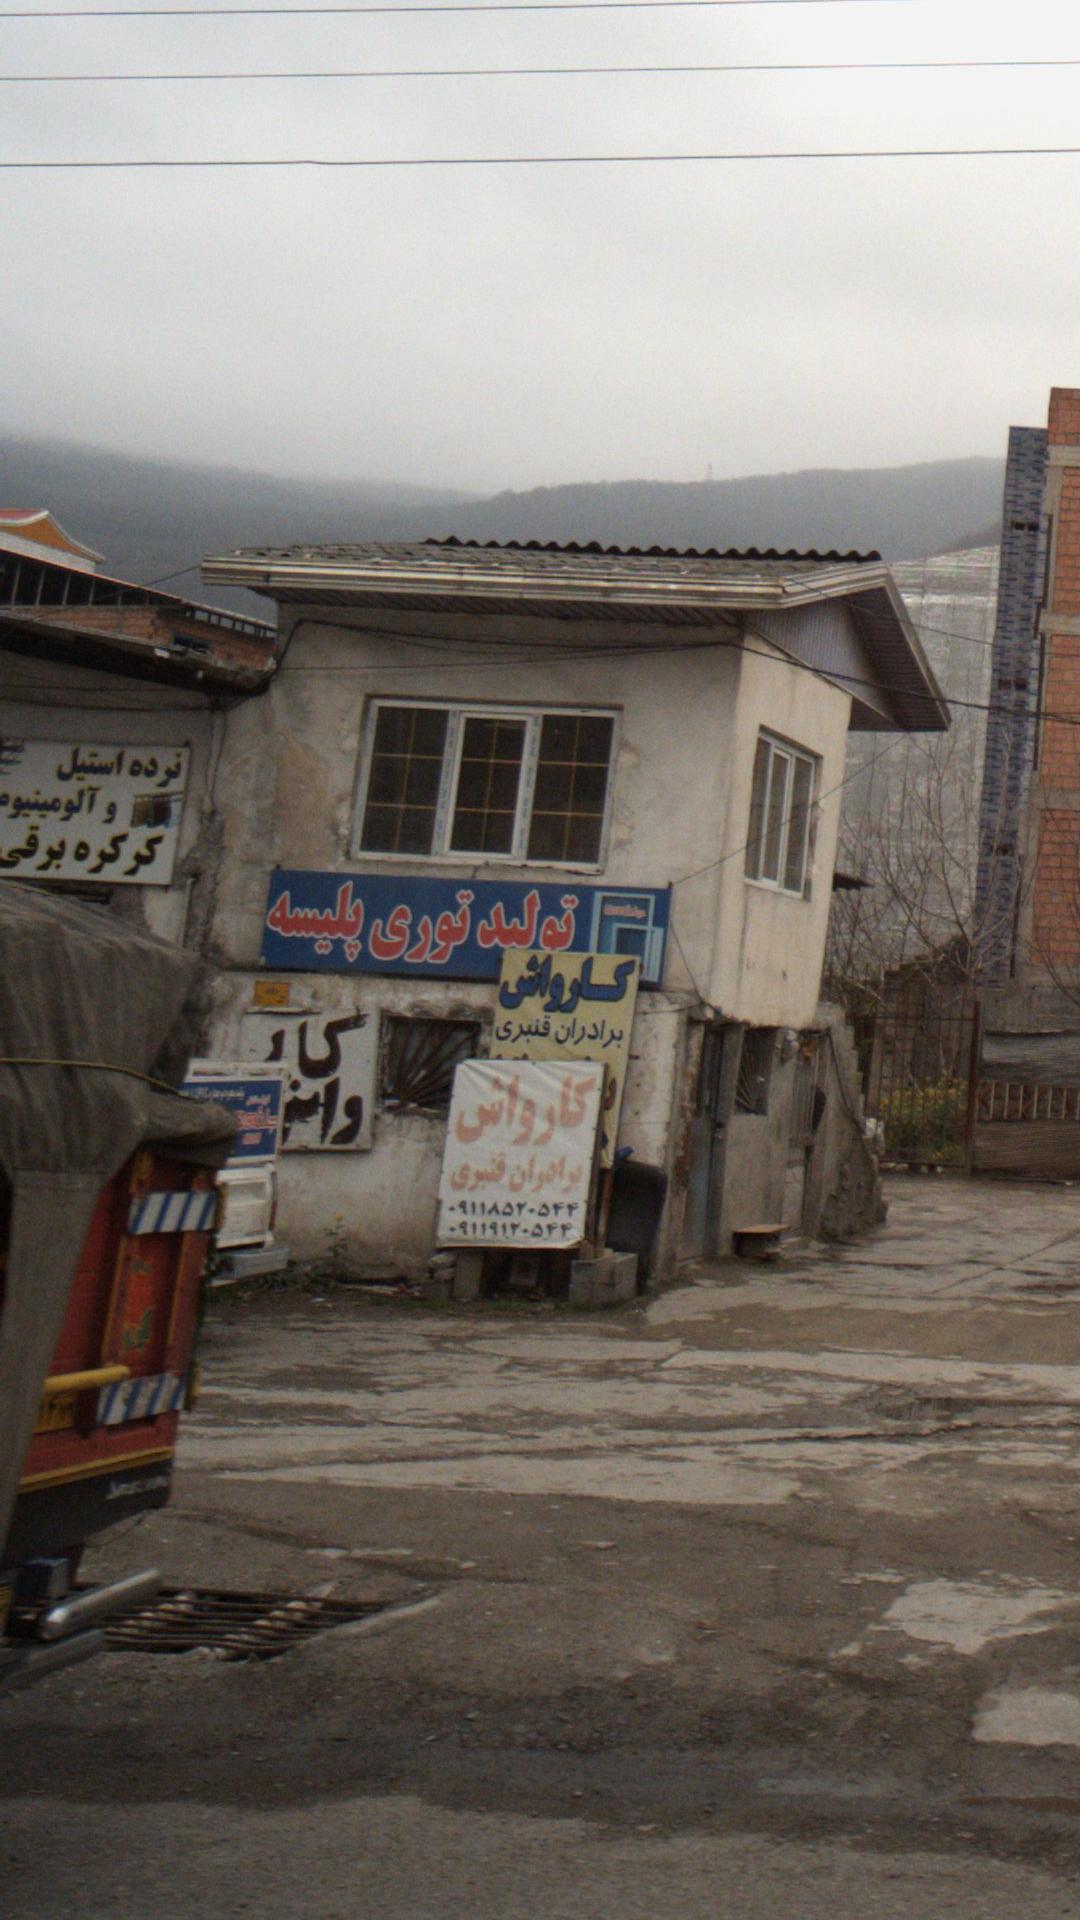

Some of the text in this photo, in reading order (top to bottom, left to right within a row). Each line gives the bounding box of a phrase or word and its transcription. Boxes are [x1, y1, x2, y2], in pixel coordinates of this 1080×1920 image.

[57, 747, 182, 787] نرده استیل
[102, 802, 117, 824] و
[0, 825, 66, 871] برقی
[267, 881, 578, 963] تولید توری پلیسه
[495, 1015, 624, 1048] برادران قنبری
[451, 1152, 583, 1193] برادران قنبری
